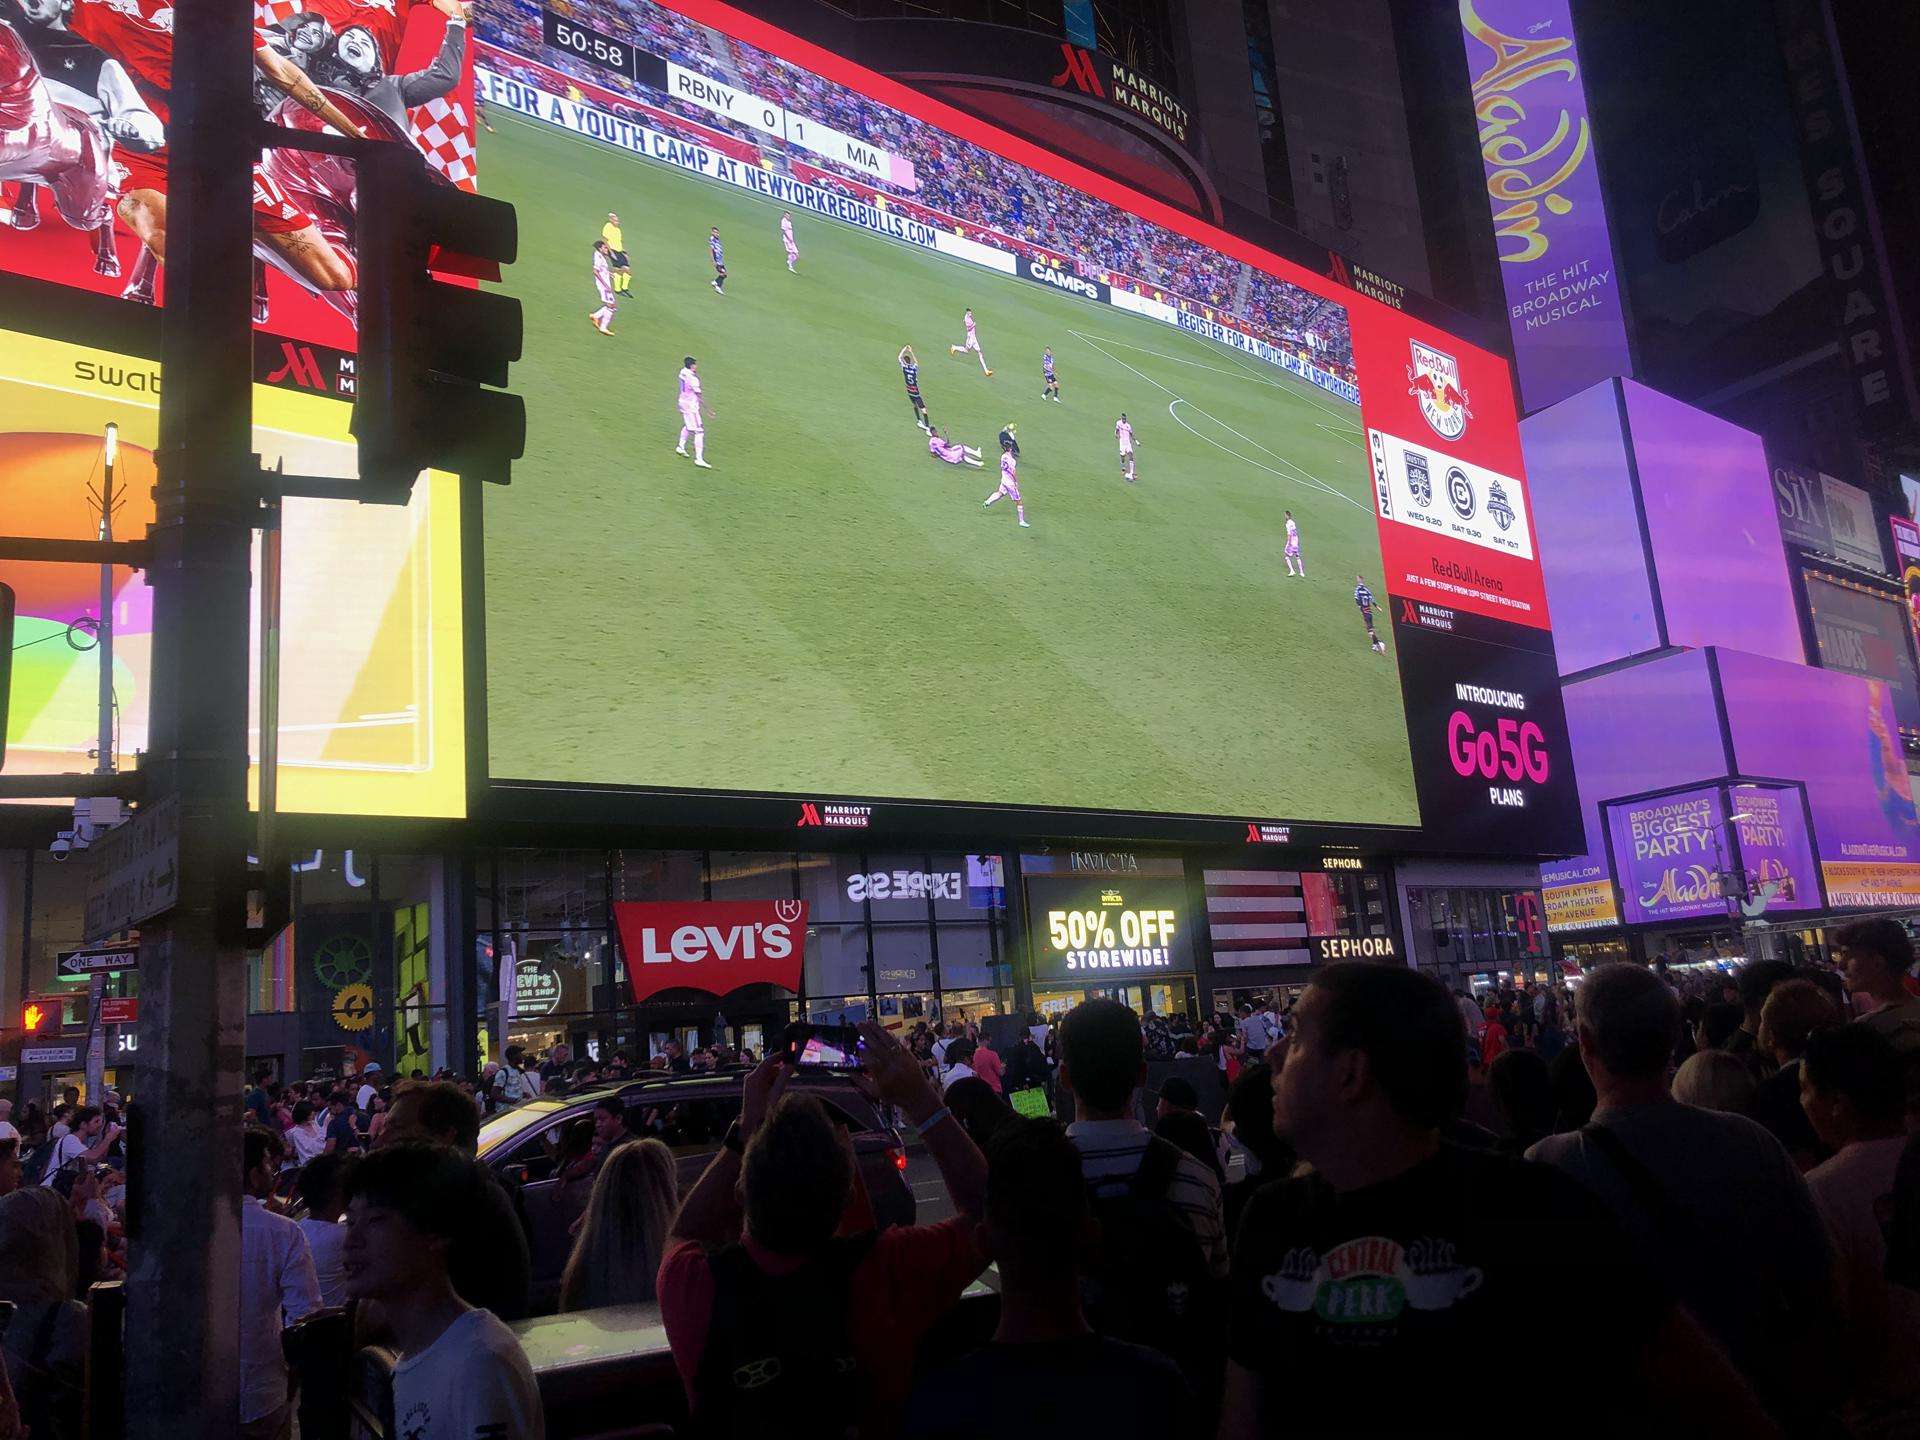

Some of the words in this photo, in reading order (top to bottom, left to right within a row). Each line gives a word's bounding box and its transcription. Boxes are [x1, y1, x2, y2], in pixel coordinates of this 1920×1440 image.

[556, 24, 623, 67] 50:58
[678, 74, 734, 110] RBNY
[763, 109, 775, 128] 0
[1112, 64, 1188, 125] MARRIOTT
[1115, 86, 1185, 141] MARQUIS
[796, 124, 804, 140] 1
[847, 142, 880, 171] MIA
[490, 76, 539, 119] FOR
[550, 98, 564, 123] A
[572, 107, 646, 153] YOUTH
[654, 130, 709, 172] CAMP
[717, 161, 737, 185] AT
[745, 167, 936, 248] NEWYORKREDBULLS.COM
[1030, 262, 1098, 299] CAMPS
[1354, 265, 1405, 297] MARRIOTT
[1524, 273, 1557, 295] THE
[1562, 259, 1590, 280] HIT
[1356, 280, 1401, 310] MARQUIS
[1511, 270, 1610, 319] BROADWAY
[1525, 293, 1602, 331] MUSICAL
[1177, 311, 1224, 343] REGISTER
[1227, 330, 1245, 350] FOR
[1248, 339, 1255, 353] A
[1257, 340, 1282, 367] YOUTH
[1284, 353, 1301, 373] CAMP
[1407, 510, 1424, 522] WED
[1452, 524, 1465, 534] SAT
[1493, 536, 1506, 546] SAT
[1474, 570, 1503, 591] Arena
[1419, 604, 1454, 619] MARRIOTT
[1420, 616, 1452, 630] MARQUIS
[1455, 683, 1525, 710] INTRODUCING
[1448, 711, 1549, 784] Go5G
[1489, 787, 1524, 807] PLANS
[824, 805, 871, 816] MARRIOTT
[825, 815, 867, 826] MARQUIS
[1629, 799, 1710, 823] BROADWAY'S
[1261, 826, 1290, 835] MARRIOTT
[1631, 810, 1710, 840] BIGGEST
[1262, 834, 1288, 843] MARQUIS
[1741, 825, 1785, 847] PARTY!
[1070, 852, 1138, 872] INVICTA
[1322, 858, 1362, 869] SEPHORA
[1573, 889, 1582, 898] AT
[1583, 886, 1599, 896] THE
[1565, 908, 1596, 919] AVENUE
[1648, 907, 1659, 916] THE
[1669, 903, 1701, 913] BROADWAY
[1048, 910, 1116, 950] 50%
[1120, 910, 1175, 948] OFF
[1320, 938, 1394, 959] SEPHORA
[70, 957, 93, 968] ONE
[104, 953, 129, 966] WAY
[1066, 949, 1169, 970] STOREWIDE!
[517, 974, 552, 988] EVI'S
[535, 988, 555, 996] SHOP
[1328, 1285, 1393, 1316] PERK
